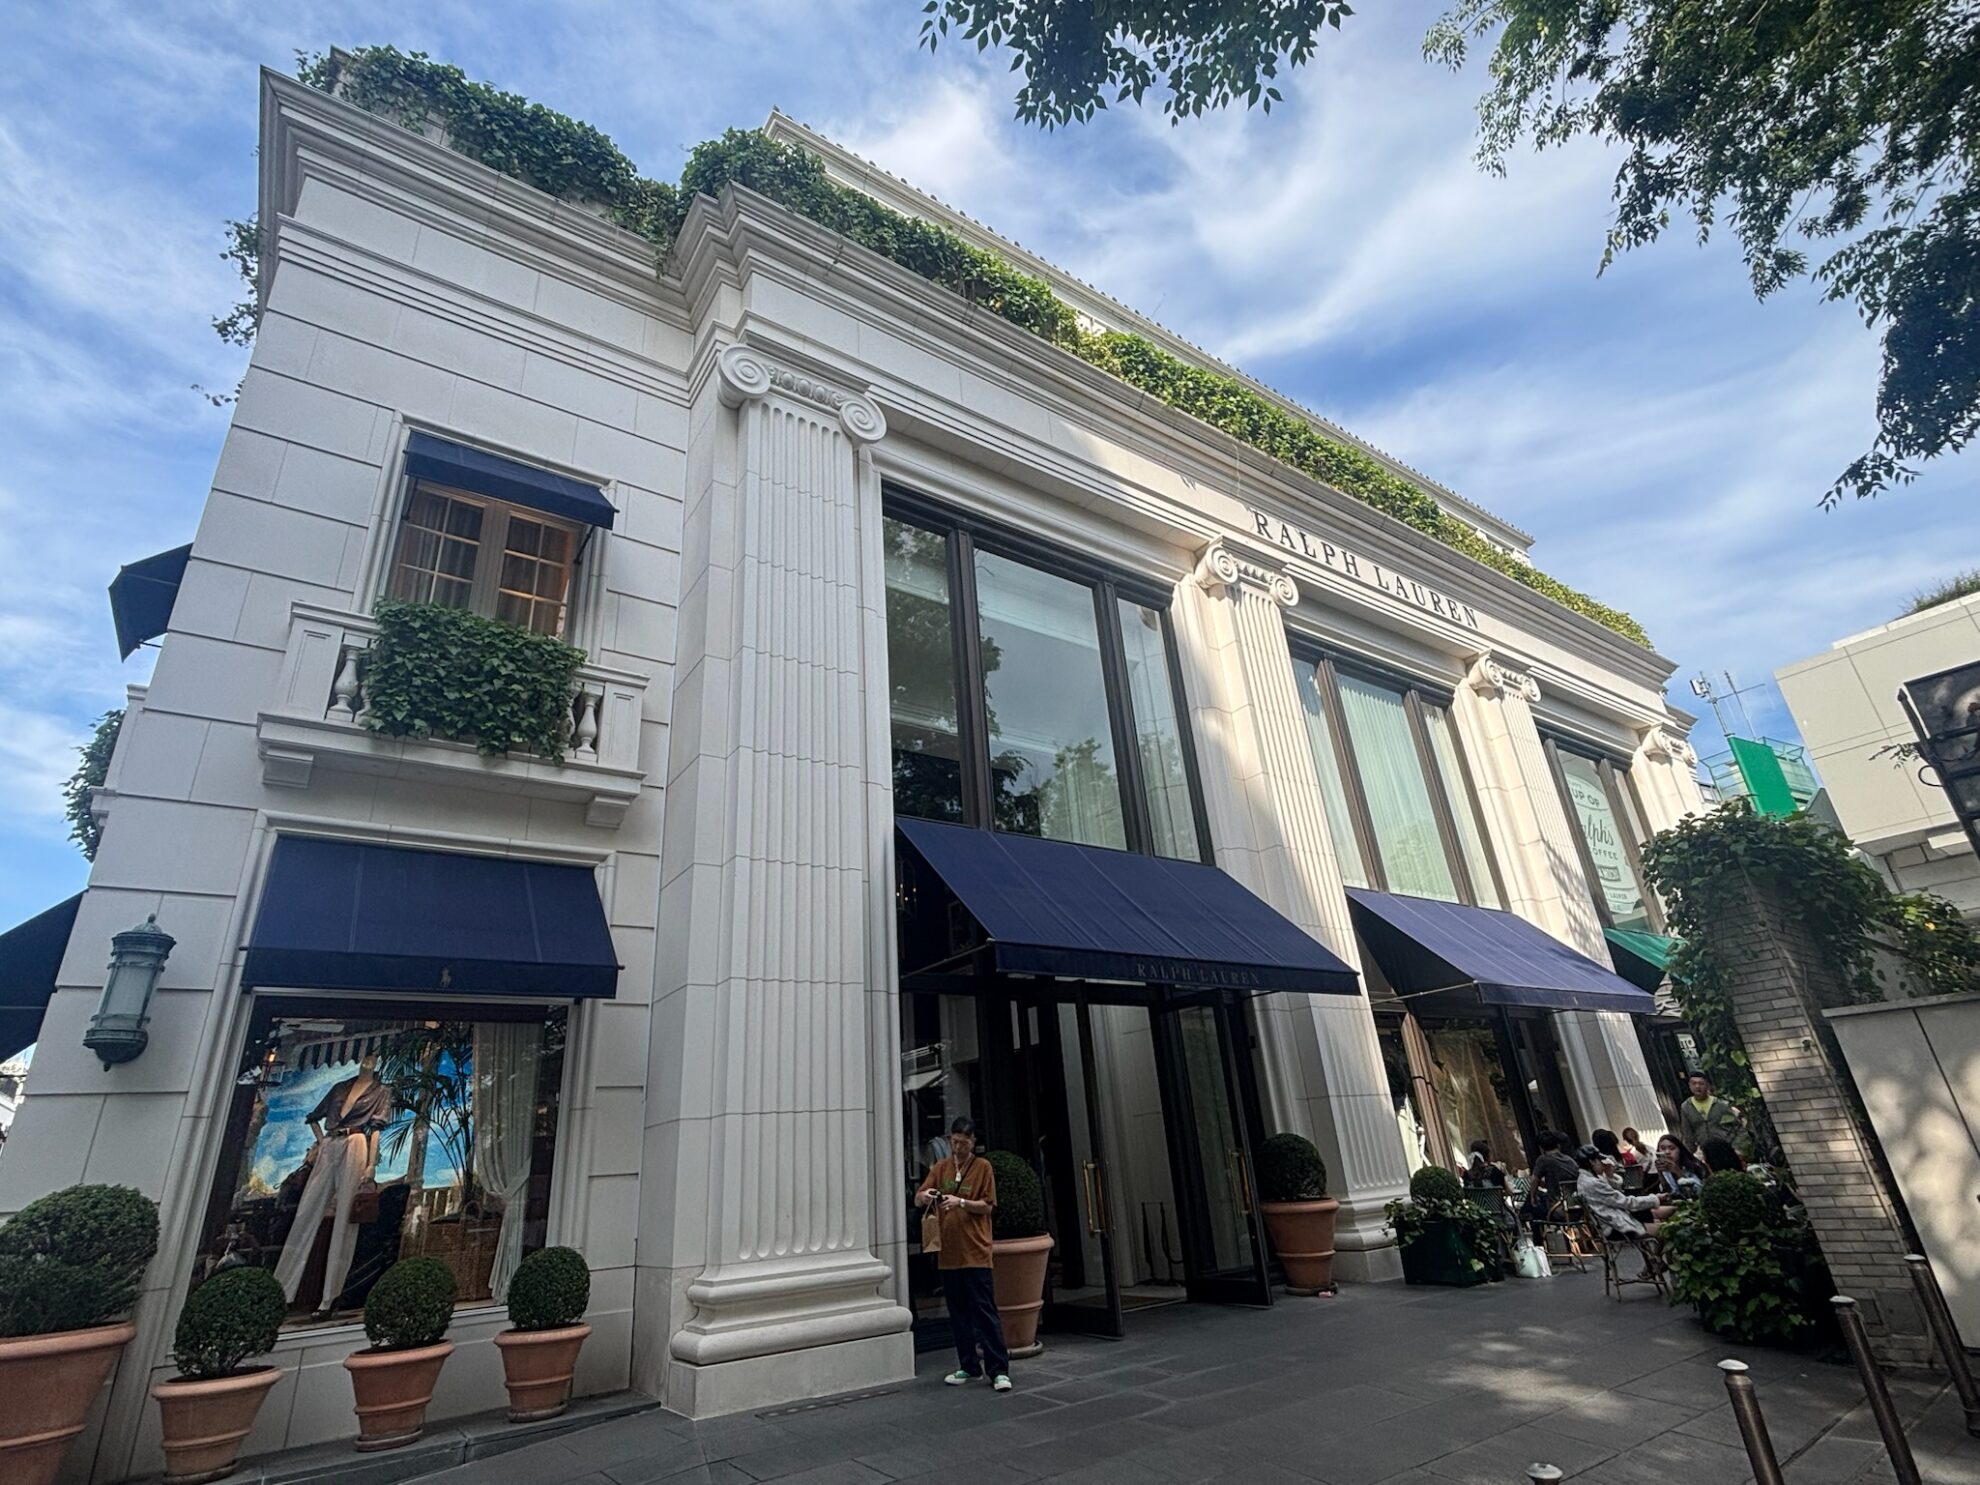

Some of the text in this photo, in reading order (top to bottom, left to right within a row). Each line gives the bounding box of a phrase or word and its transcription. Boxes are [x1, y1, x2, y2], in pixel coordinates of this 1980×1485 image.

[1252, 510, 1478, 629] RALPH LAUREN
[1137, 963, 1261, 985] RALPH LAUREN
